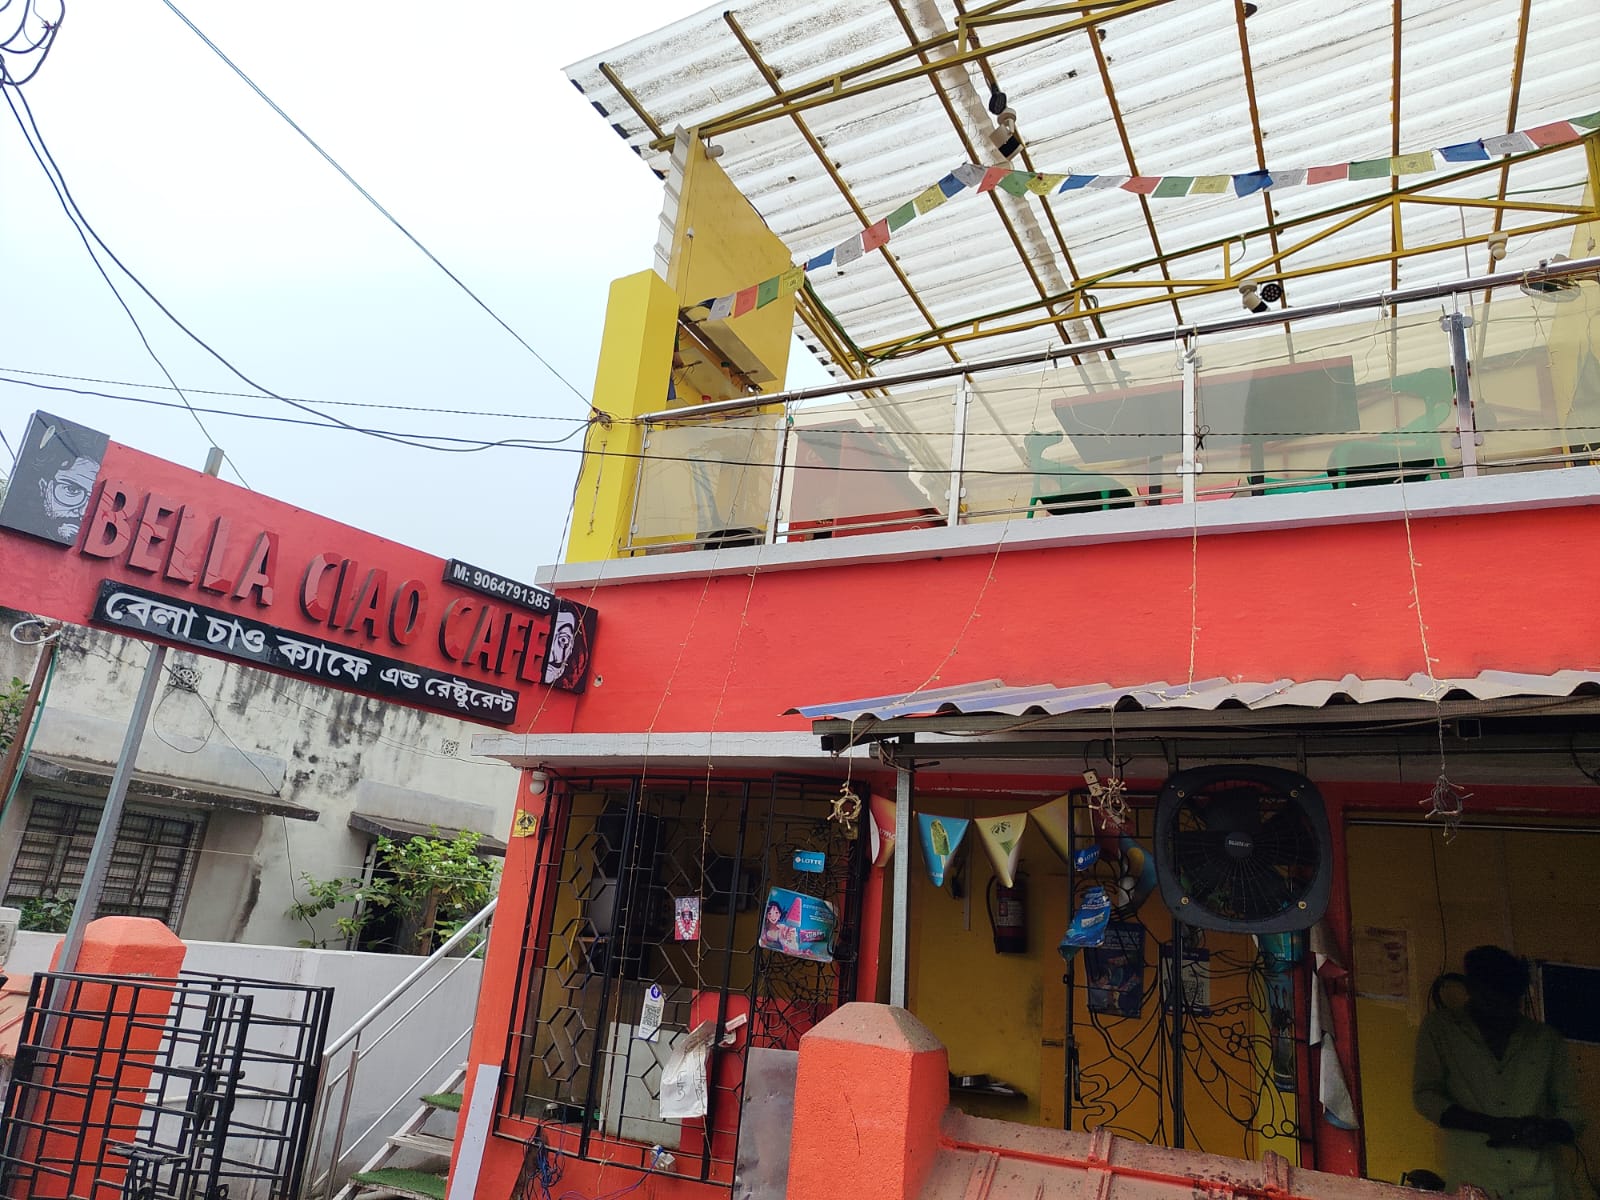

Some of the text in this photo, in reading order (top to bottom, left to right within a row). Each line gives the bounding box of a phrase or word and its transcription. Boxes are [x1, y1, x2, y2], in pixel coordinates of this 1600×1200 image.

[80, 479, 551, 683] BELLA CIAO CAFE
[453, 563, 551, 610] M: 9064791385
[106, 592, 199, 639] বেলা
[205, 615, 266, 653] চাও
[276, 634, 372, 682] ক্যাফে
[379, 667, 421, 689] এন্ড
